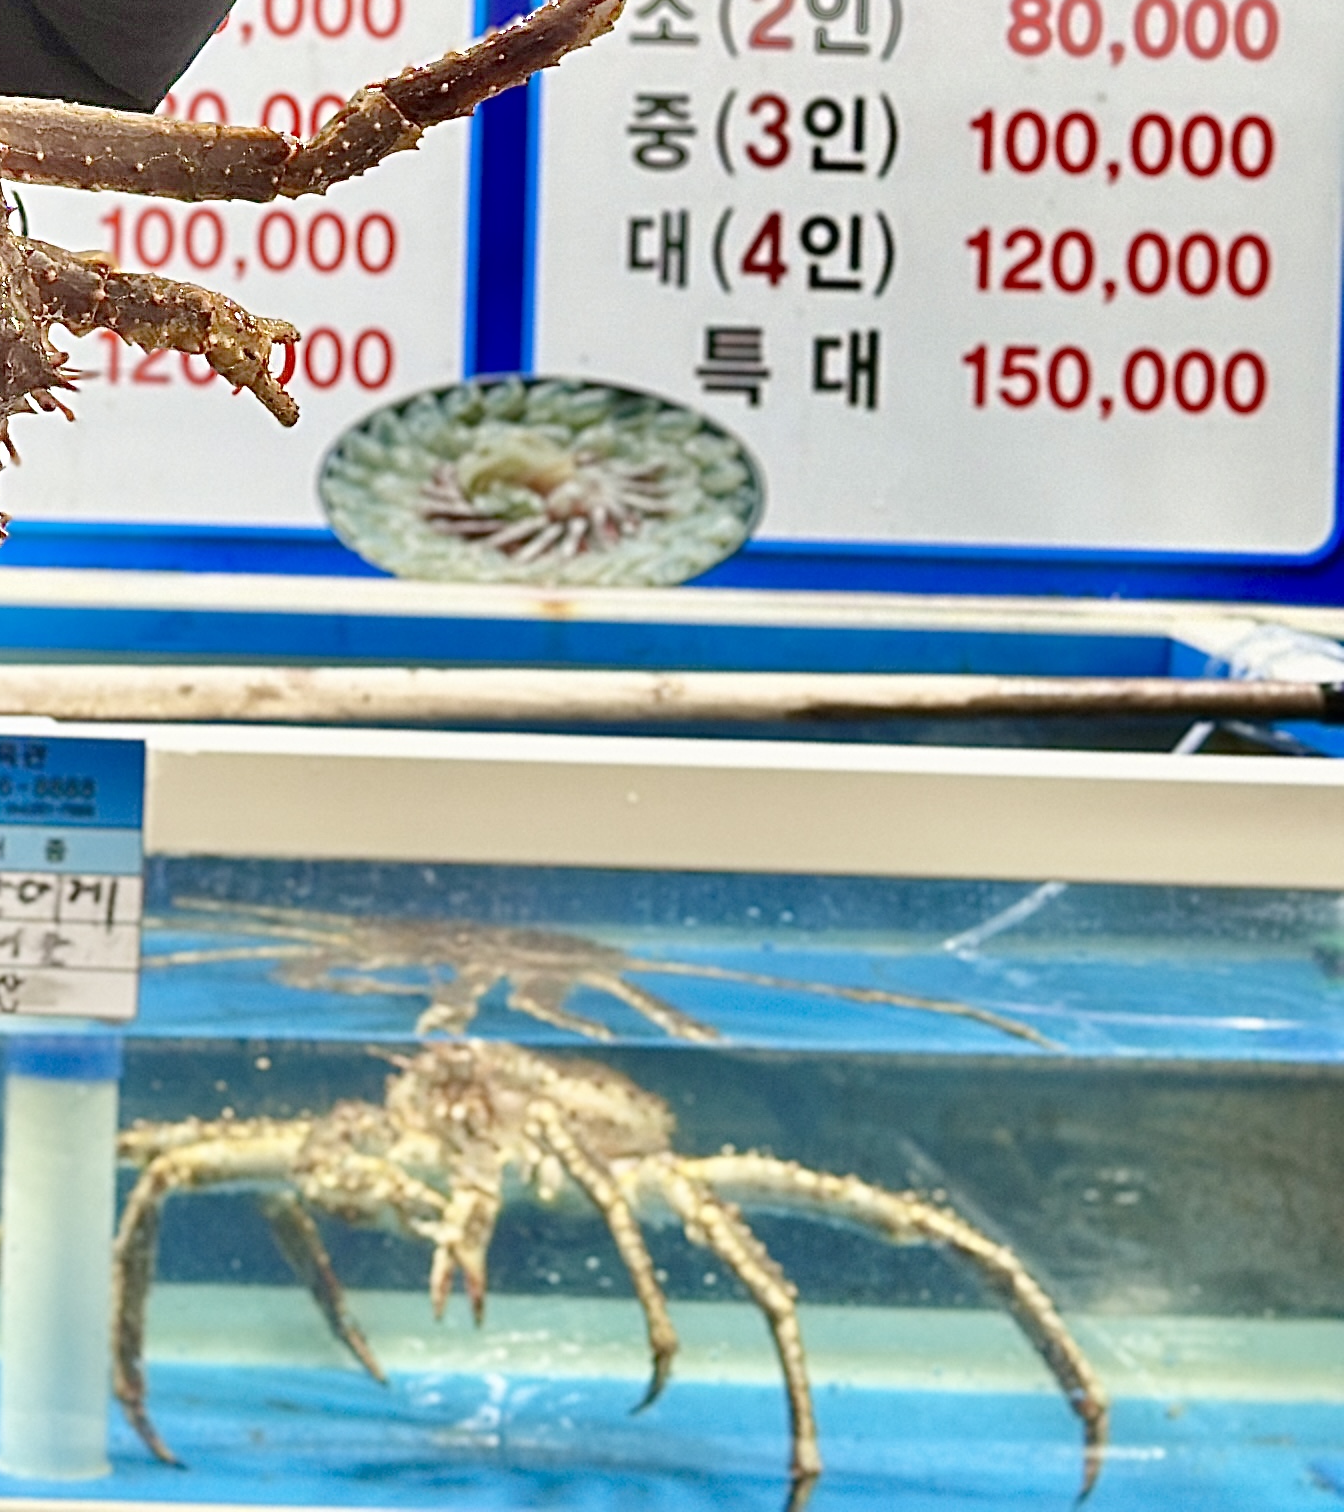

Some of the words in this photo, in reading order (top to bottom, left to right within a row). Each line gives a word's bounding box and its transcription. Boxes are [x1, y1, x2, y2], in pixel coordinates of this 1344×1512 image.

[968, 108, 1276, 186] 100,000
[100, 205, 397, 279] 100,000
[965, 226, 1272, 305] 120,000
[961, 343, 1269, 421] 150,000
